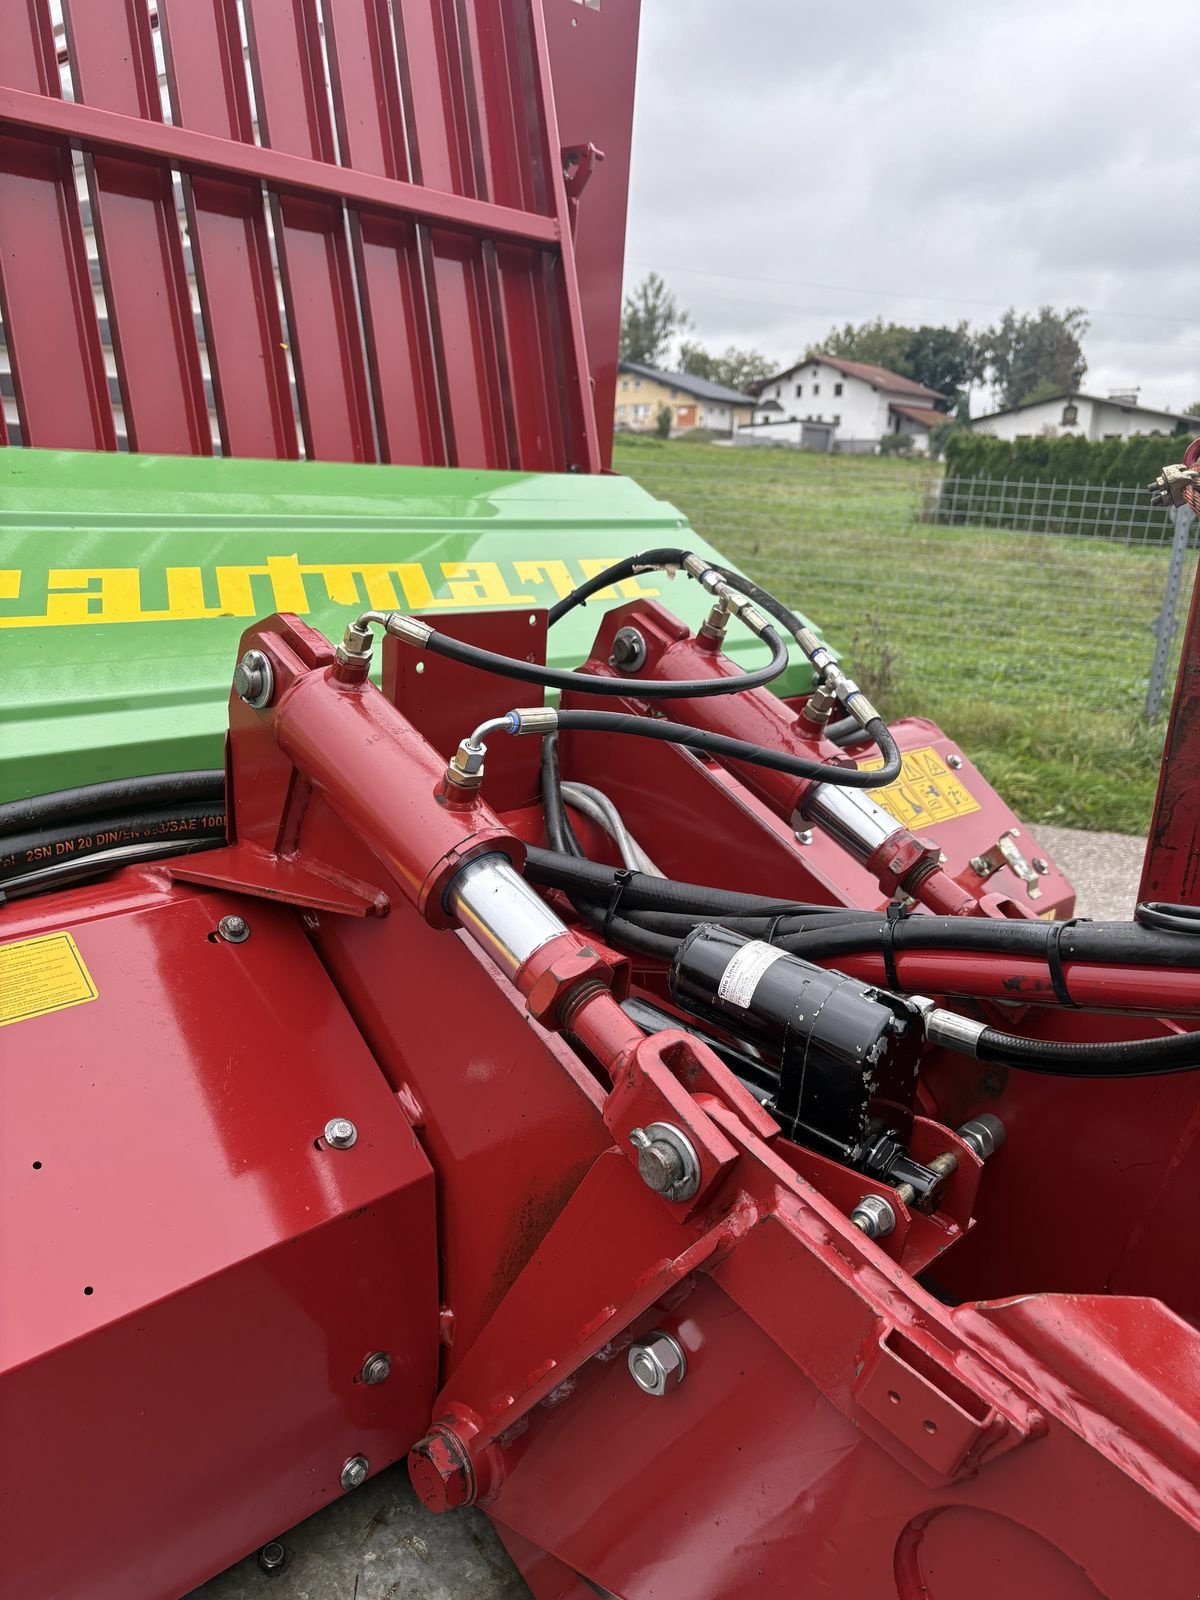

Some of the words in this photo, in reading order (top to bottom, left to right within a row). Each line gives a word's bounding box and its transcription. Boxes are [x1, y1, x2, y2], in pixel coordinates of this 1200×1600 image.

[26, 846, 52, 862] 2SN
[56, 840, 75, 855] DN
[77, 837, 93, 850] 20
